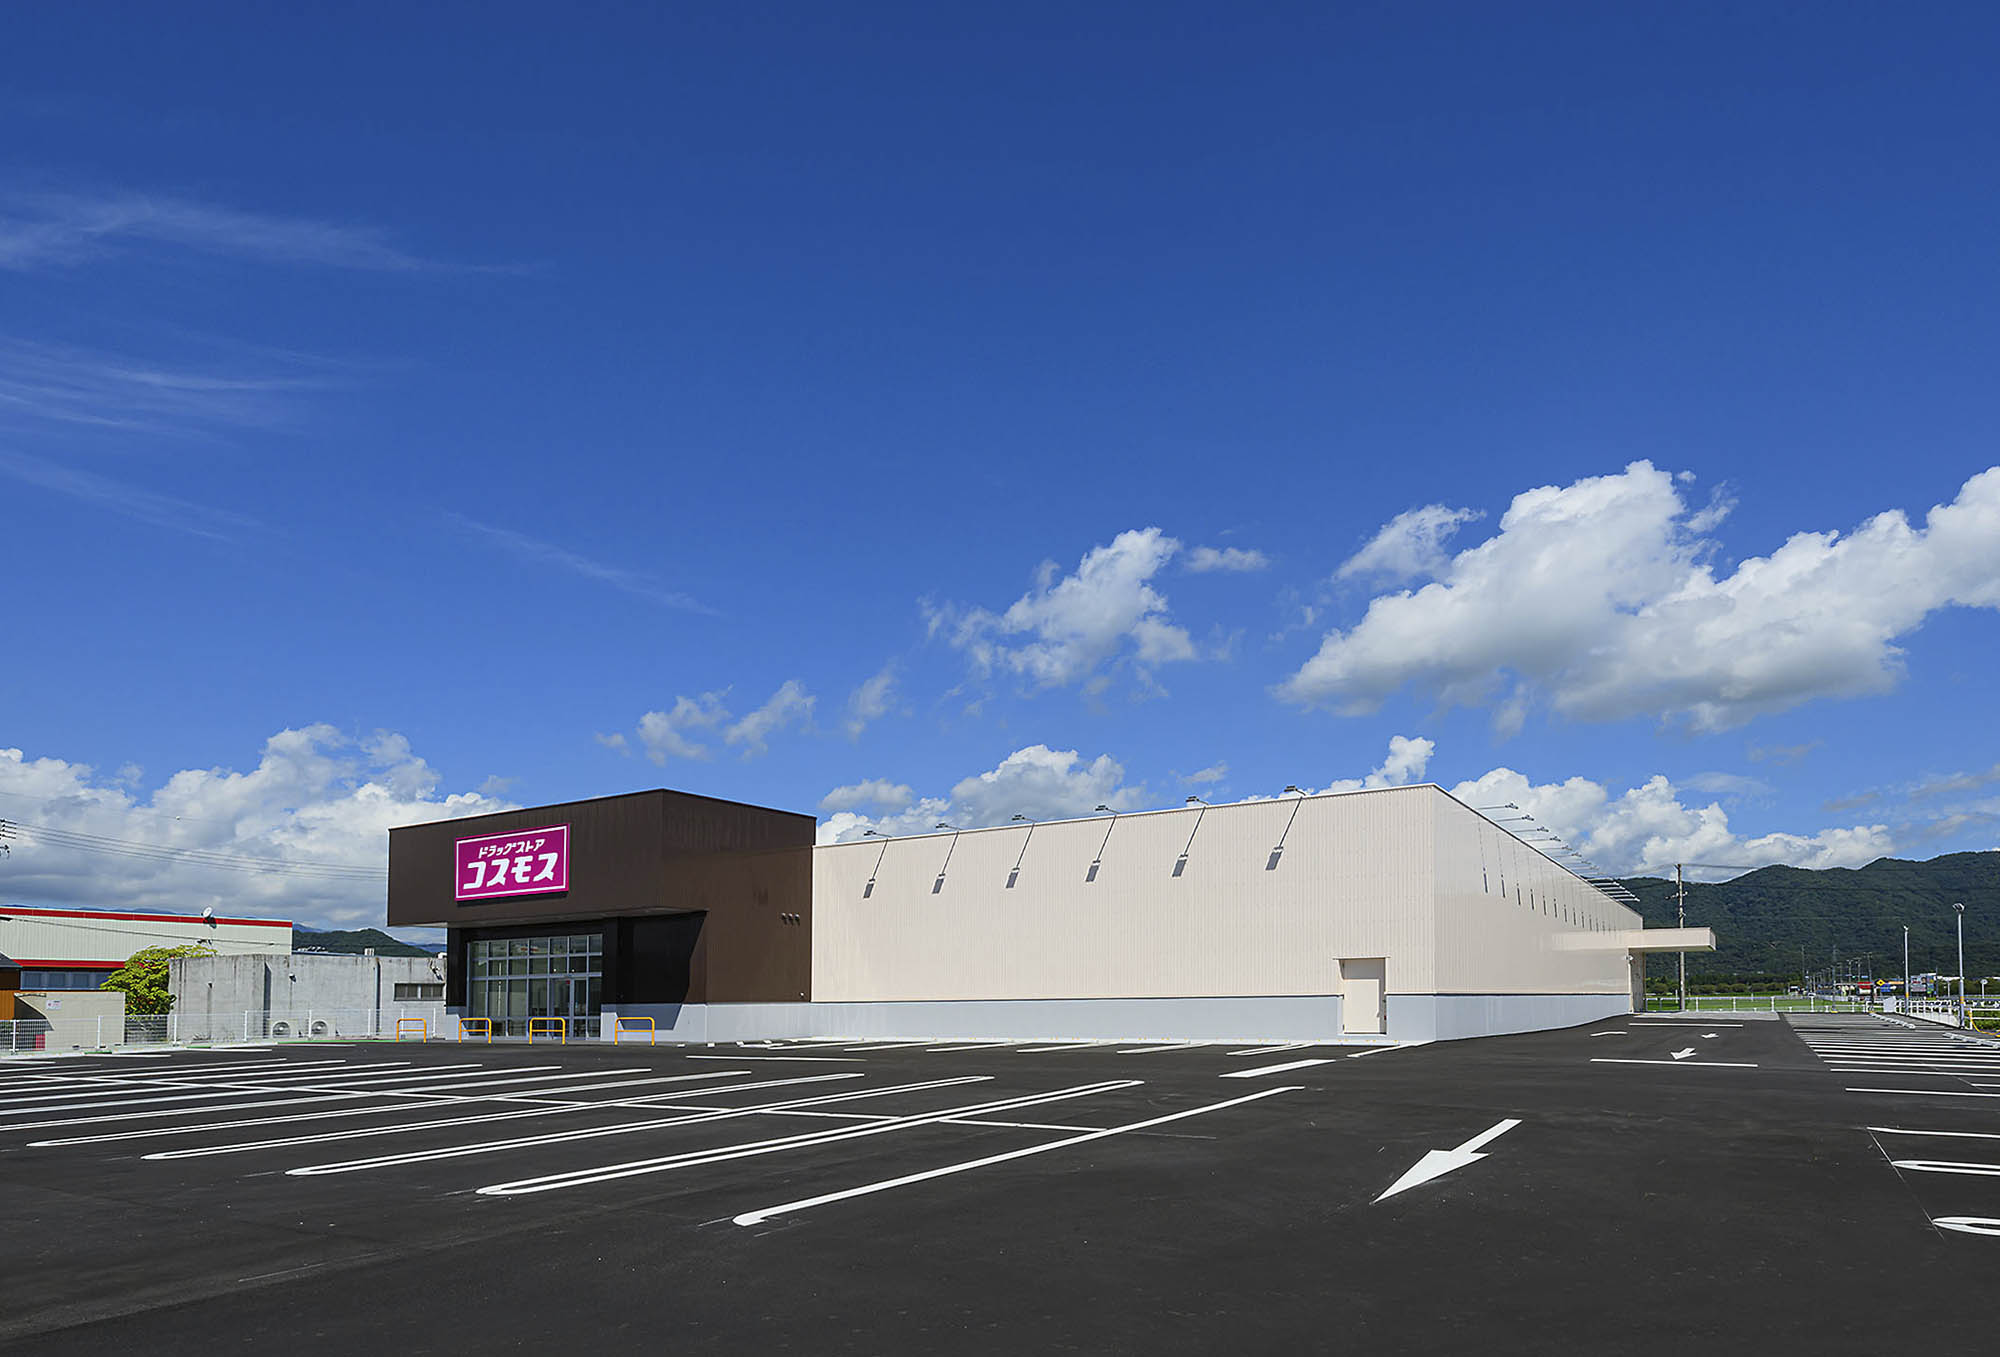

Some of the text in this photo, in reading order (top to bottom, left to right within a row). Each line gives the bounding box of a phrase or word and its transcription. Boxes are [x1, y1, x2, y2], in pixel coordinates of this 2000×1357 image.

[478, 838, 545, 859] ドラッグストア
[463, 852, 558, 889] コスモス
